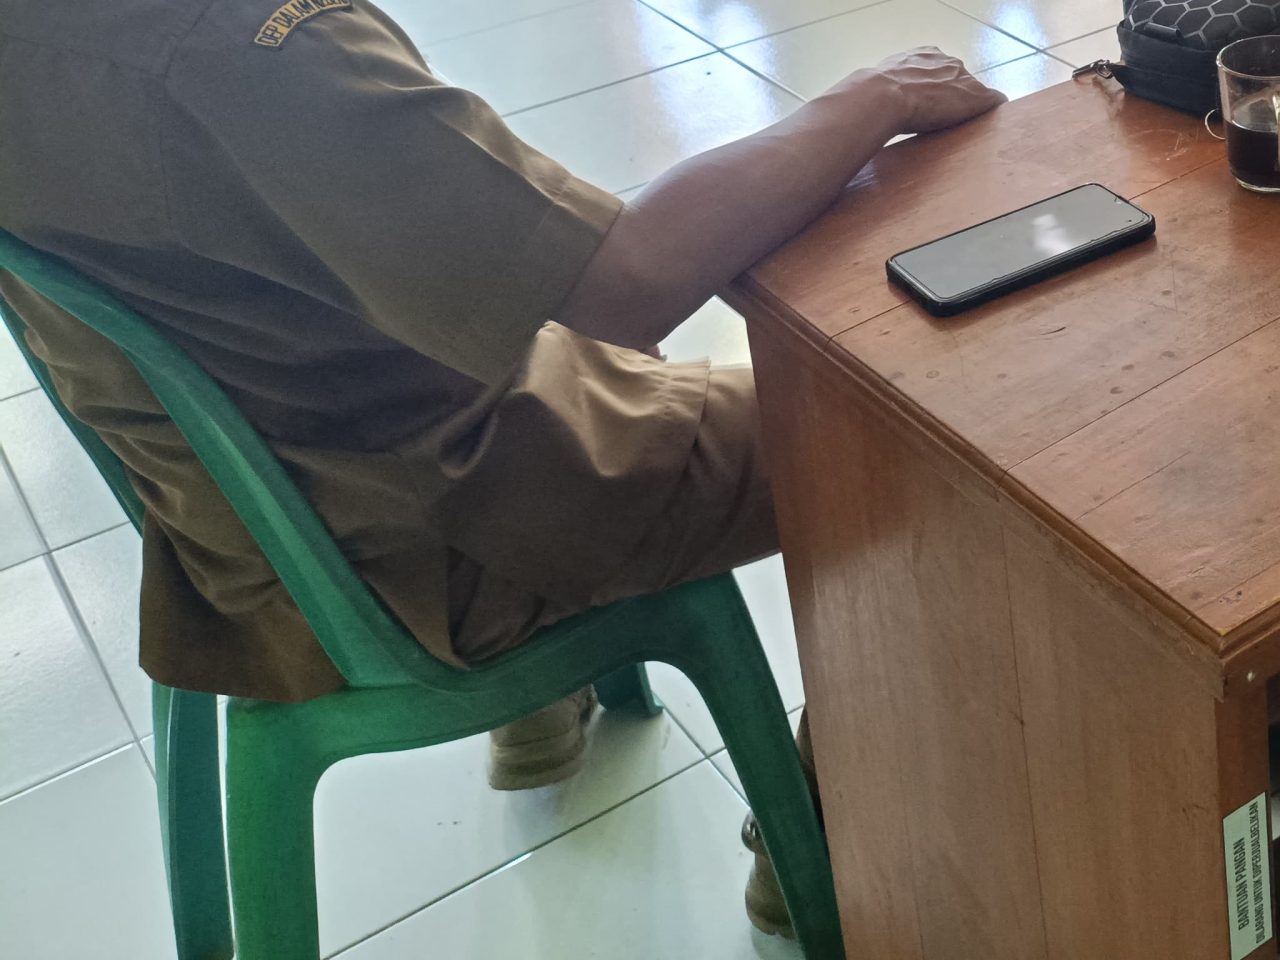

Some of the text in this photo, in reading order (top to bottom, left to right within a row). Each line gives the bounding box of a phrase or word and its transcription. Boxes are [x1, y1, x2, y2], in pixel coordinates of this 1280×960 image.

[257, 24, 284, 45] DEP
[1233, 837, 1250, 931] BANTUAN PANGAN
